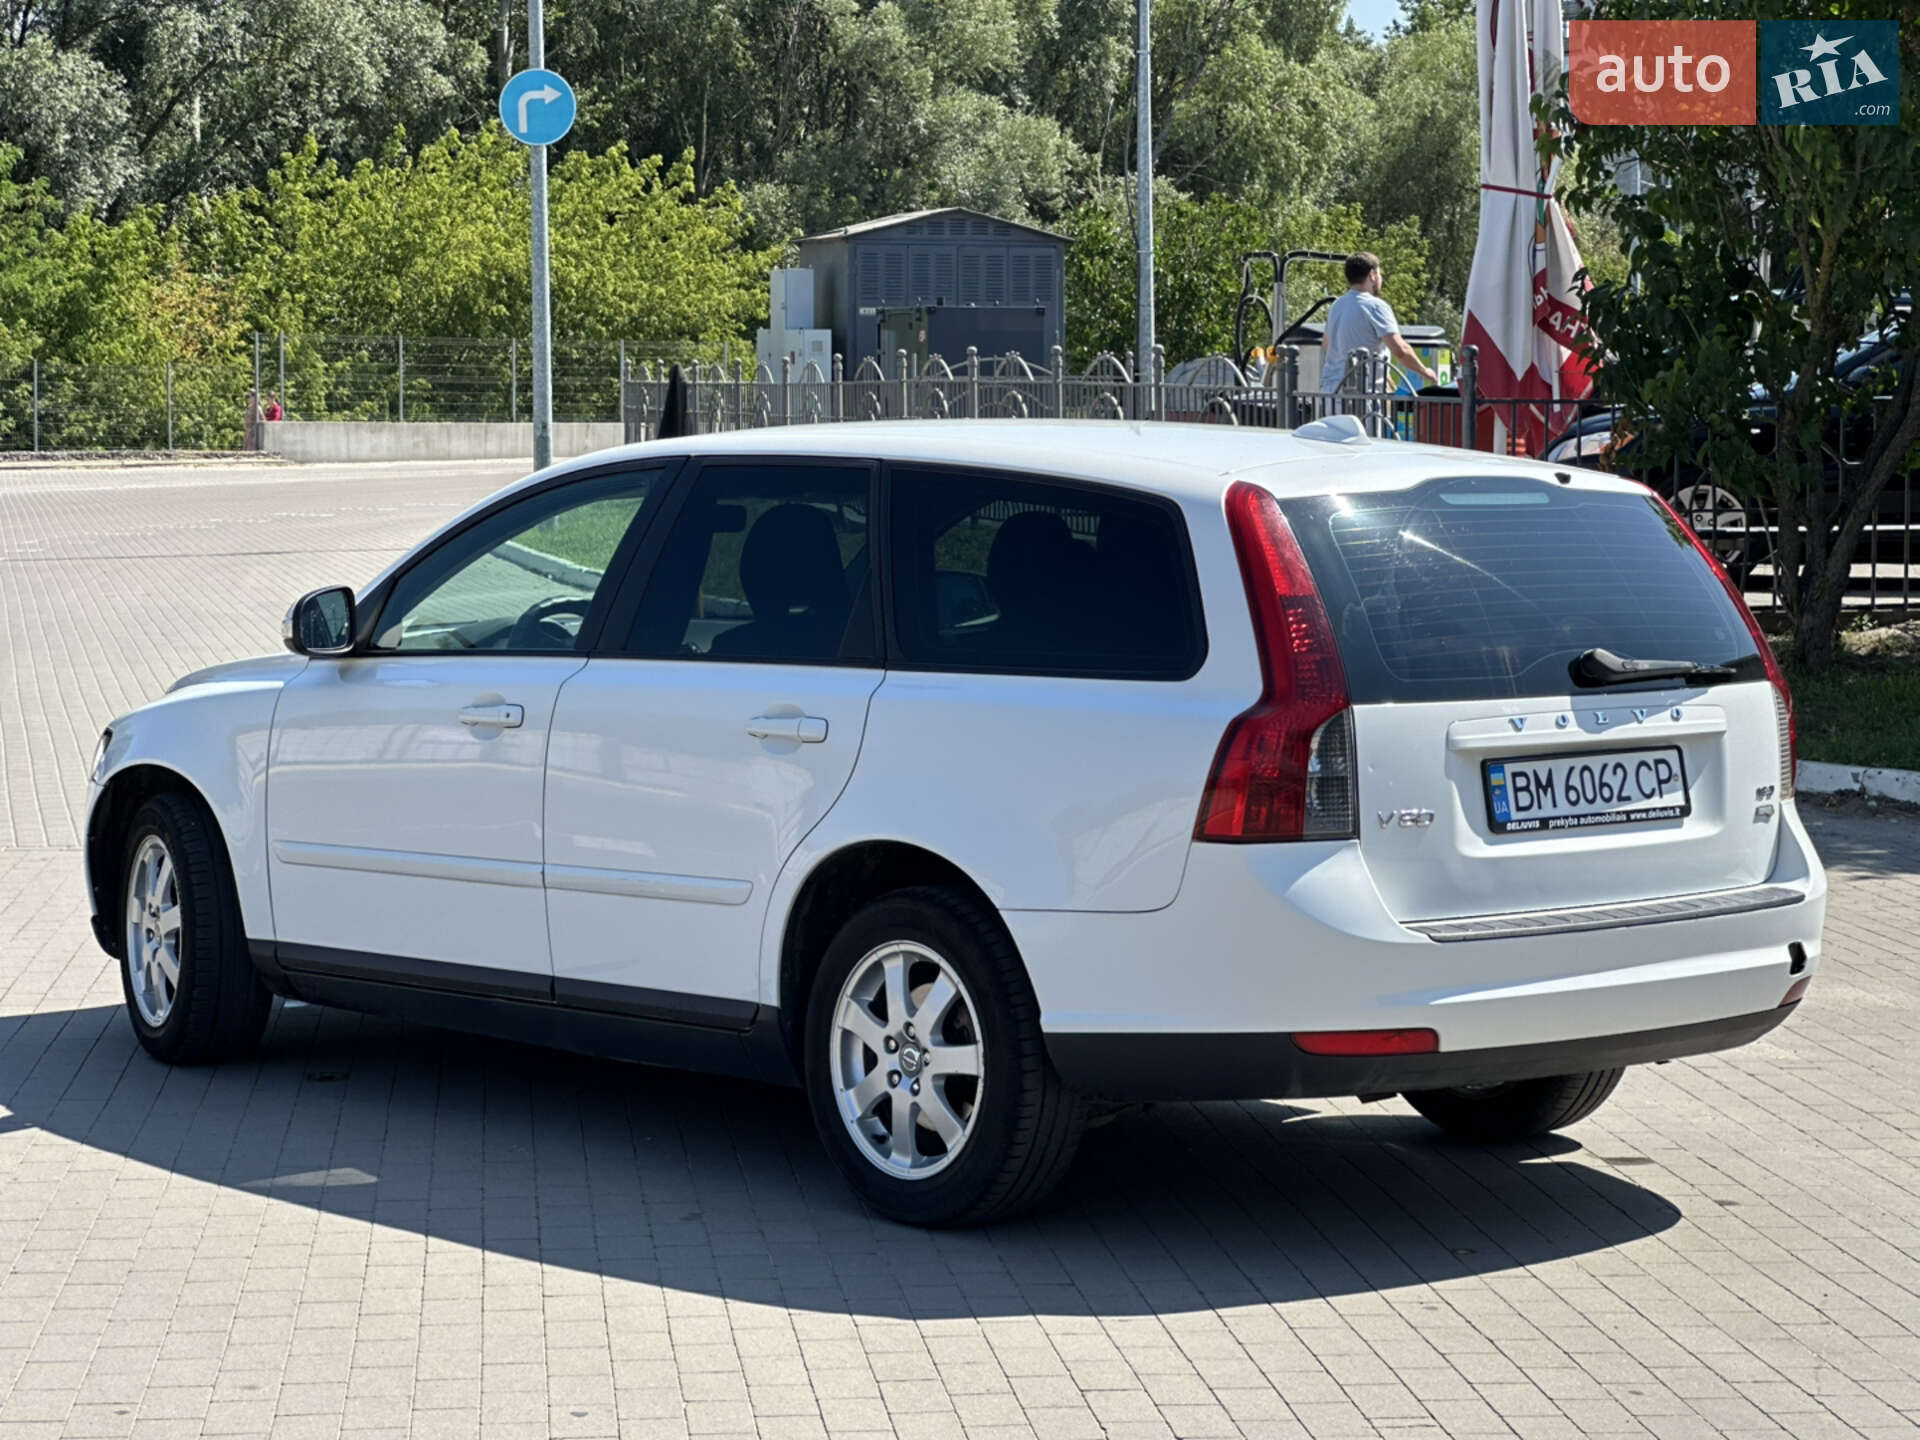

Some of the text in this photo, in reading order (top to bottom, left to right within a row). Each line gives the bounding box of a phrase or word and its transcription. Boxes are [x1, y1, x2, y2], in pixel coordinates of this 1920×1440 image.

[1508, 706, 1684, 732] VOLVO
[1511, 758, 1673, 813] BM 6062 CP
[1494, 800, 1509, 814] UA
[1549, 816, 1578, 829] prekyba
